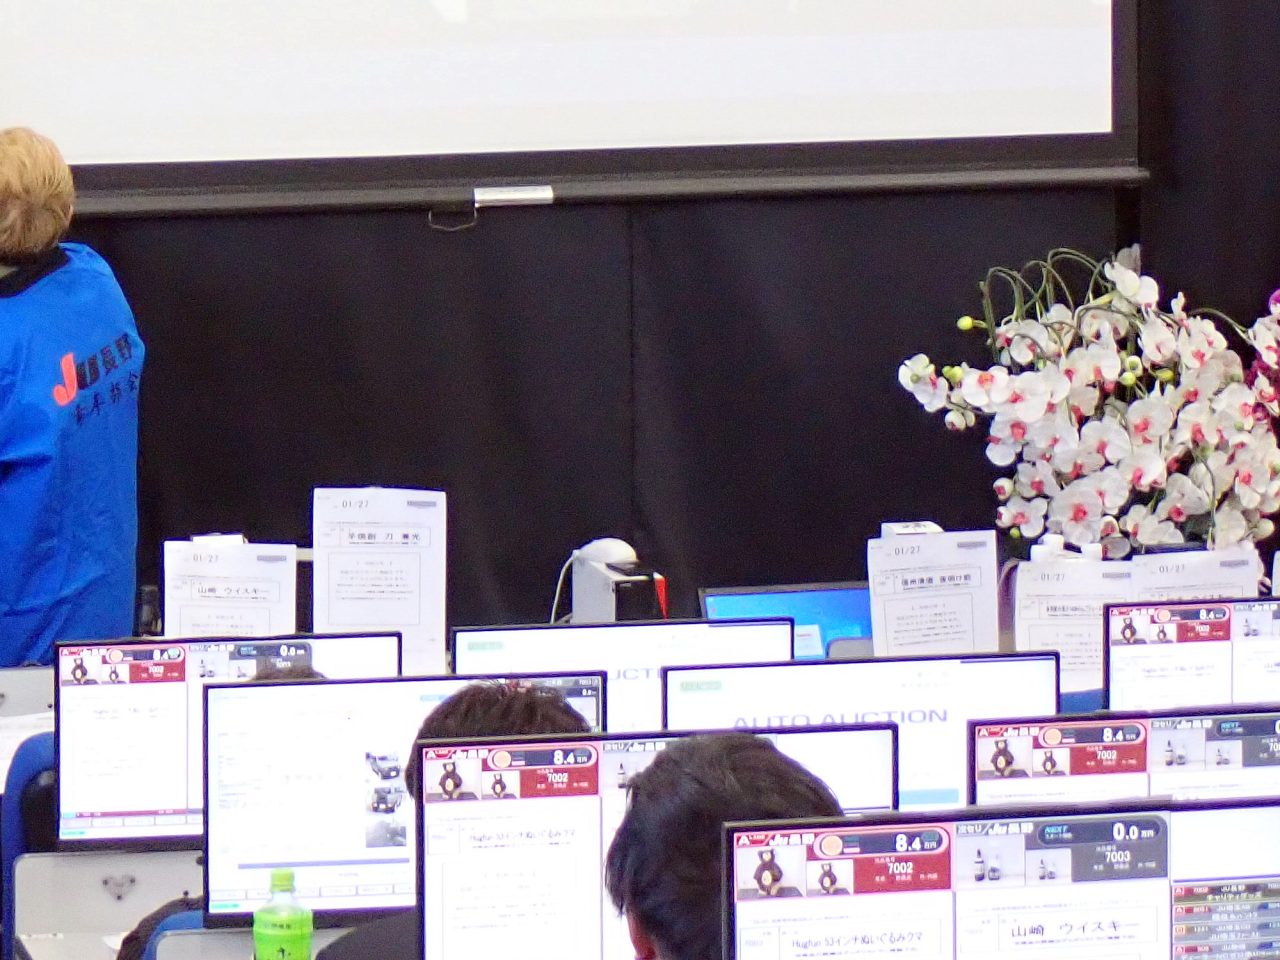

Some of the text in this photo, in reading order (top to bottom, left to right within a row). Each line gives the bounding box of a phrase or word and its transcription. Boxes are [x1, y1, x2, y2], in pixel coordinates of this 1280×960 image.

[894, 545, 921, 556] 01/27
[1158, 563, 1186, 574] 01/27
[821, 709, 949, 724] AUCTION
[1103, 727, 1124, 742] 8.4
[553, 749, 576, 765] 8.4
[546, 773, 568, 783] 7002
[1112, 822, 1139, 840] 0.0
[895, 833, 921, 852] 8.4
[1104, 851, 1131, 863] 7003
[887, 862, 914, 874] 7002
